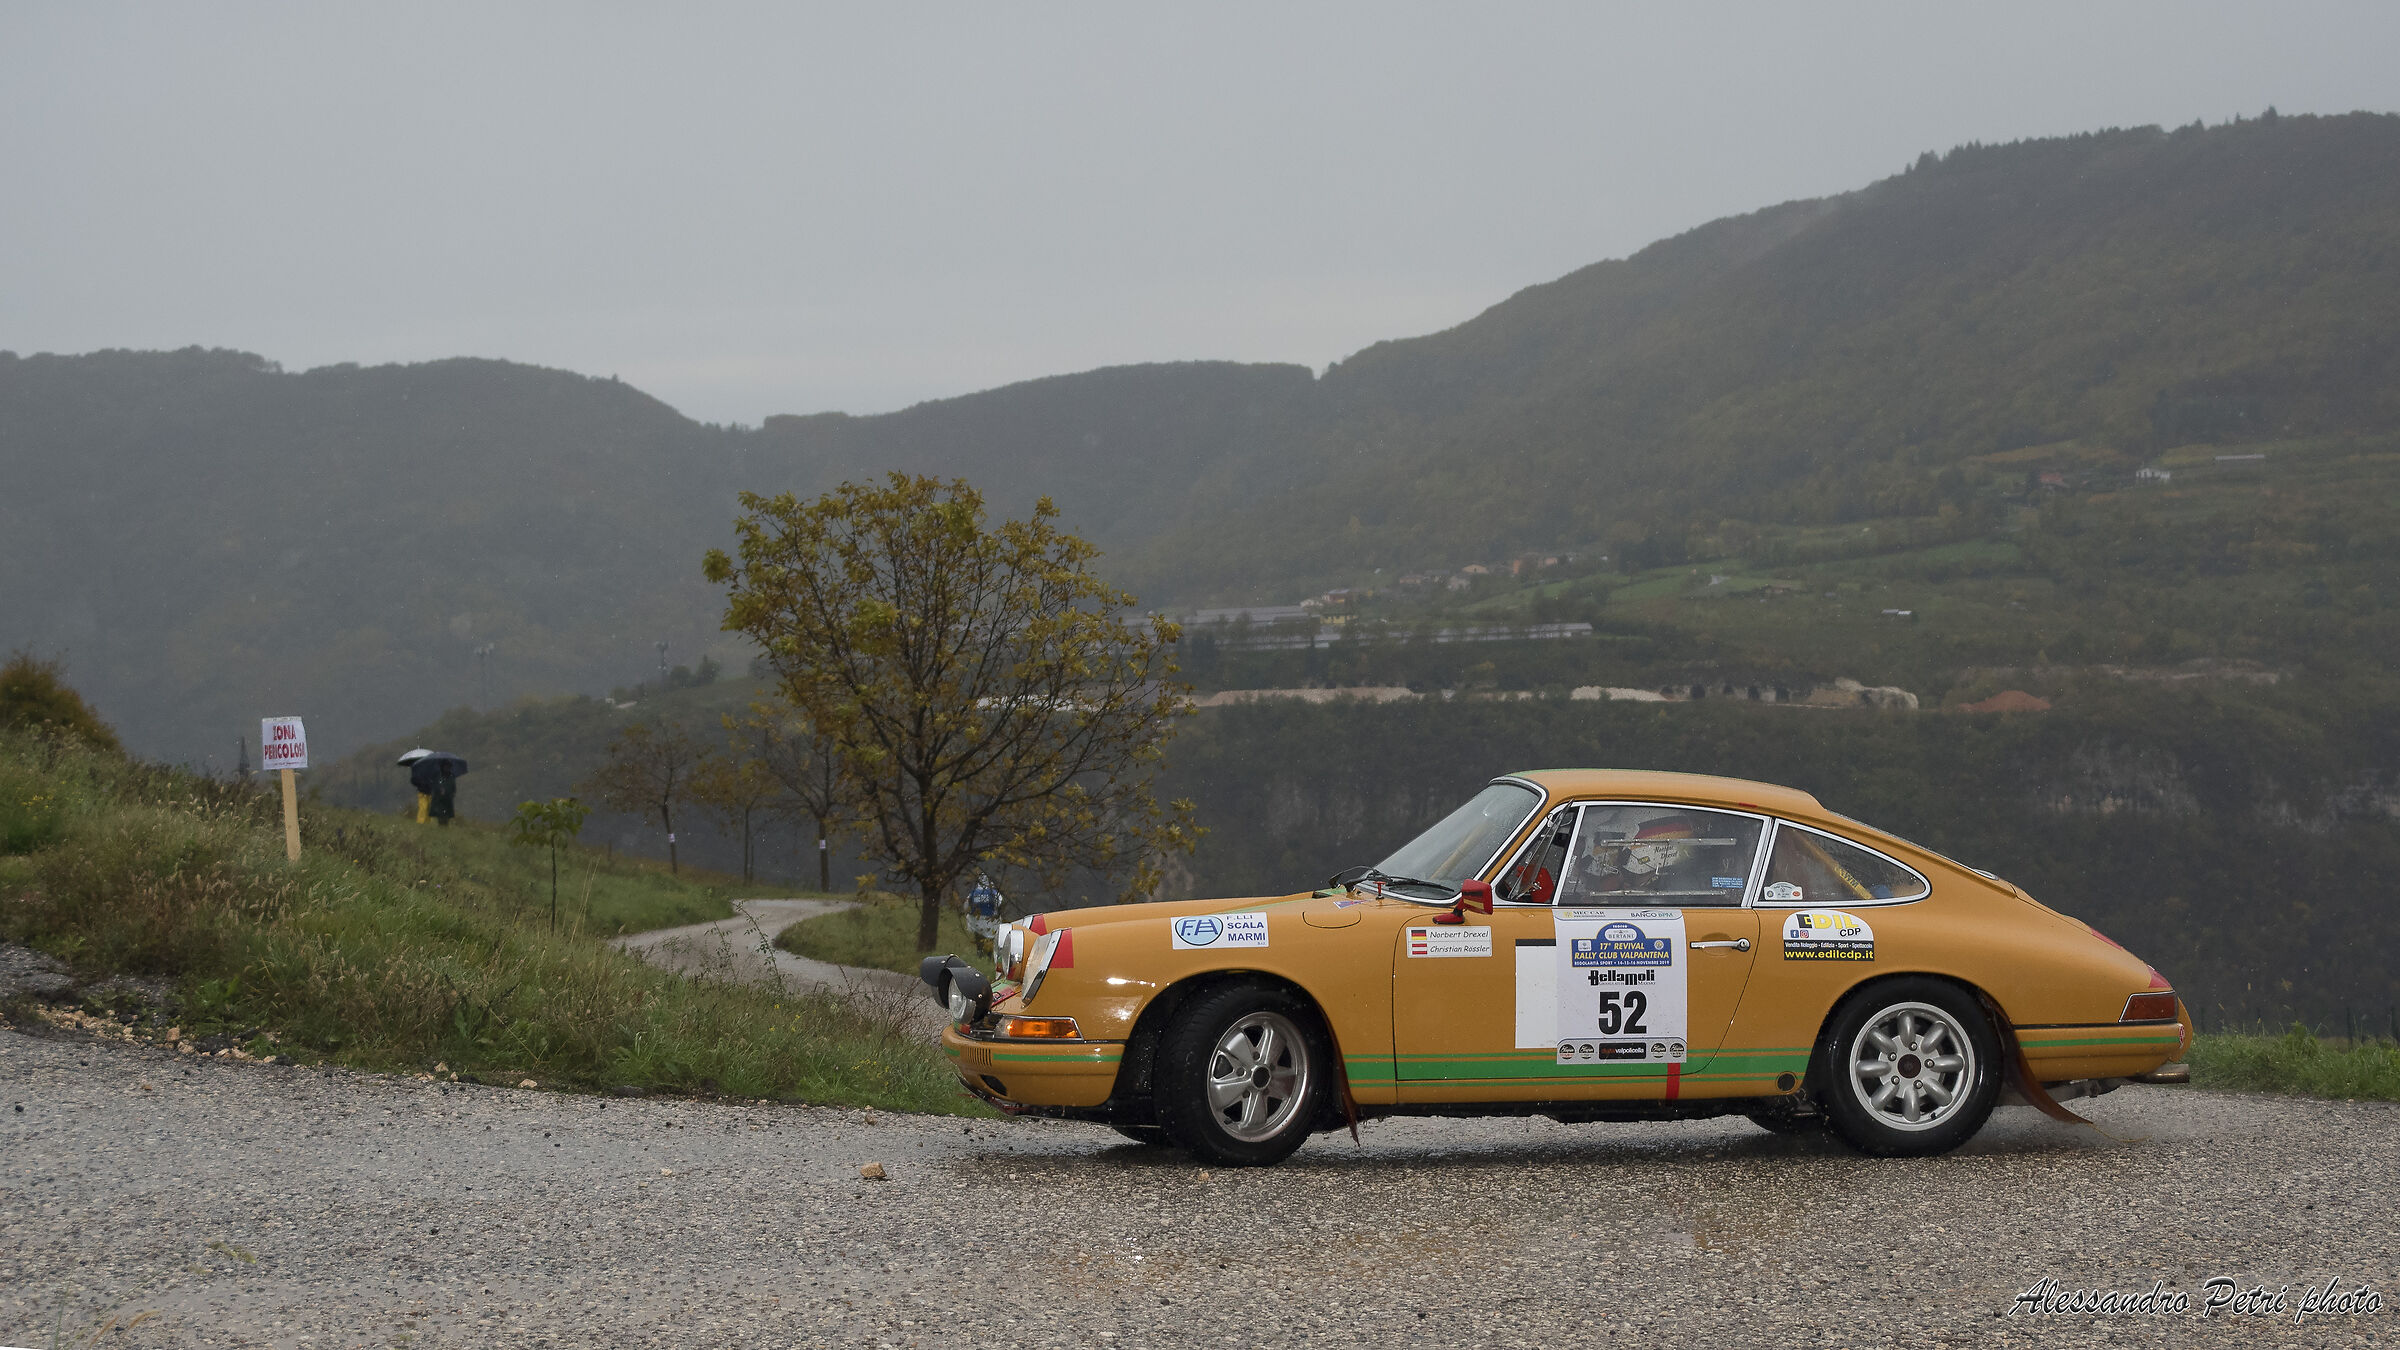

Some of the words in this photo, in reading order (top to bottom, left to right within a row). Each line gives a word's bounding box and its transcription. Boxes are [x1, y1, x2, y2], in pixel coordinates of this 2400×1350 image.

[272, 724, 297, 741] ZONA
[1796, 913, 1859, 929] EDIL
[1227, 922, 1265, 930] SCALA
[1228, 932, 1266, 941] MARMI
[1429, 930, 1461, 939] Norbert
[1463, 930, 1489, 938] Drexel
[1840, 928, 1861, 937] CDP
[1429, 945, 1462, 953] Christian
[1463, 945, 1490, 953] Rössler
[1614, 942, 1645, 950] REVIVAL
[1574, 951, 1598, 960] RALLY
[1599, 951, 1618, 959] CLUB
[1620, 951, 1670, 959] VALPANTENA
[1784, 949, 1874, 960] www.edilcdp.it
[1587, 969, 1655, 986] Bellamoli
[1598, 990, 1647, 1035] 52
